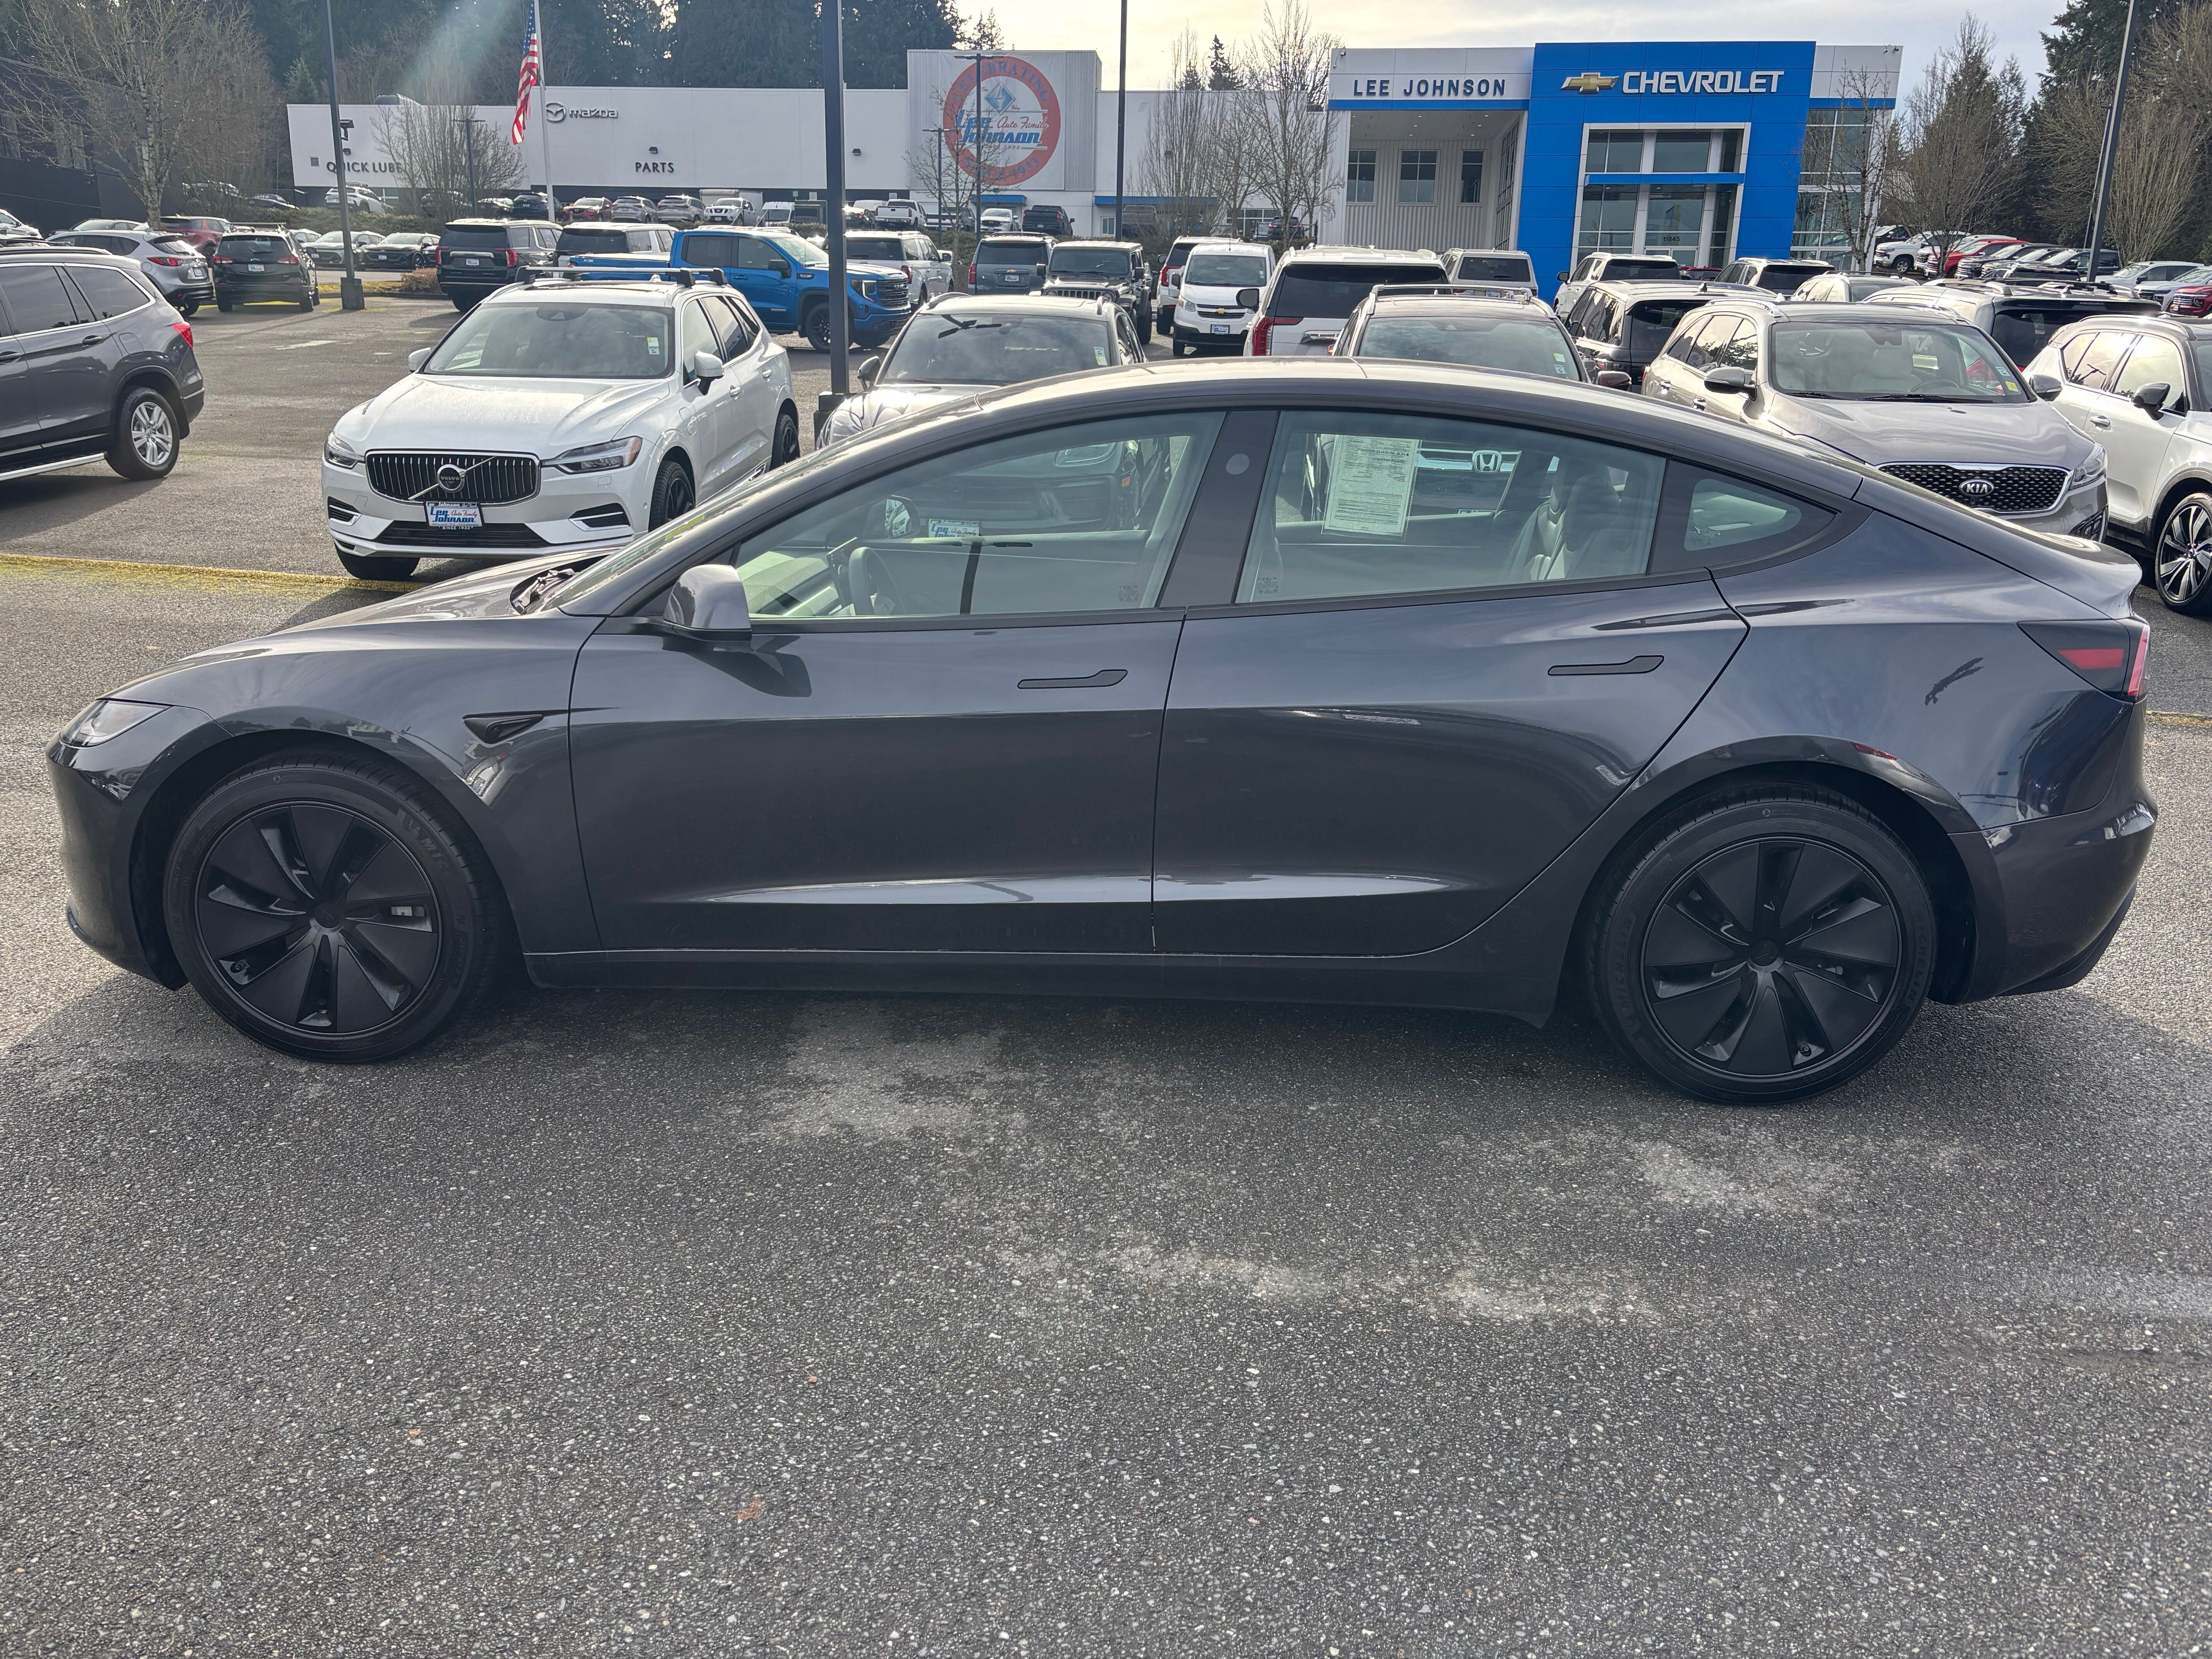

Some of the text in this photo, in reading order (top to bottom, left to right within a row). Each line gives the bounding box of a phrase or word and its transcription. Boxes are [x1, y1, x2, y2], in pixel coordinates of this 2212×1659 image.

[1353, 79, 1505, 96] LEE JOHNSON
[1623, 71, 1784, 93] CHEVROLET
[569, 108, 618, 118] mazda
[955, 110, 1049, 134] Lee Auto Family
[958, 127, 1042, 144] Johnson
[326, 161, 403, 174] QICK LUBE
[635, 162, 674, 173] PARTS
[1966, 483, 1988, 493] KIA
[430, 507, 450, 516] Lee
[462, 510, 477, 518] Family
[432, 514, 476, 523] Johnson
[1614, 916, 1633, 1009] MICHELIN
[1907, 908, 1927, 1002] MICHELIN
